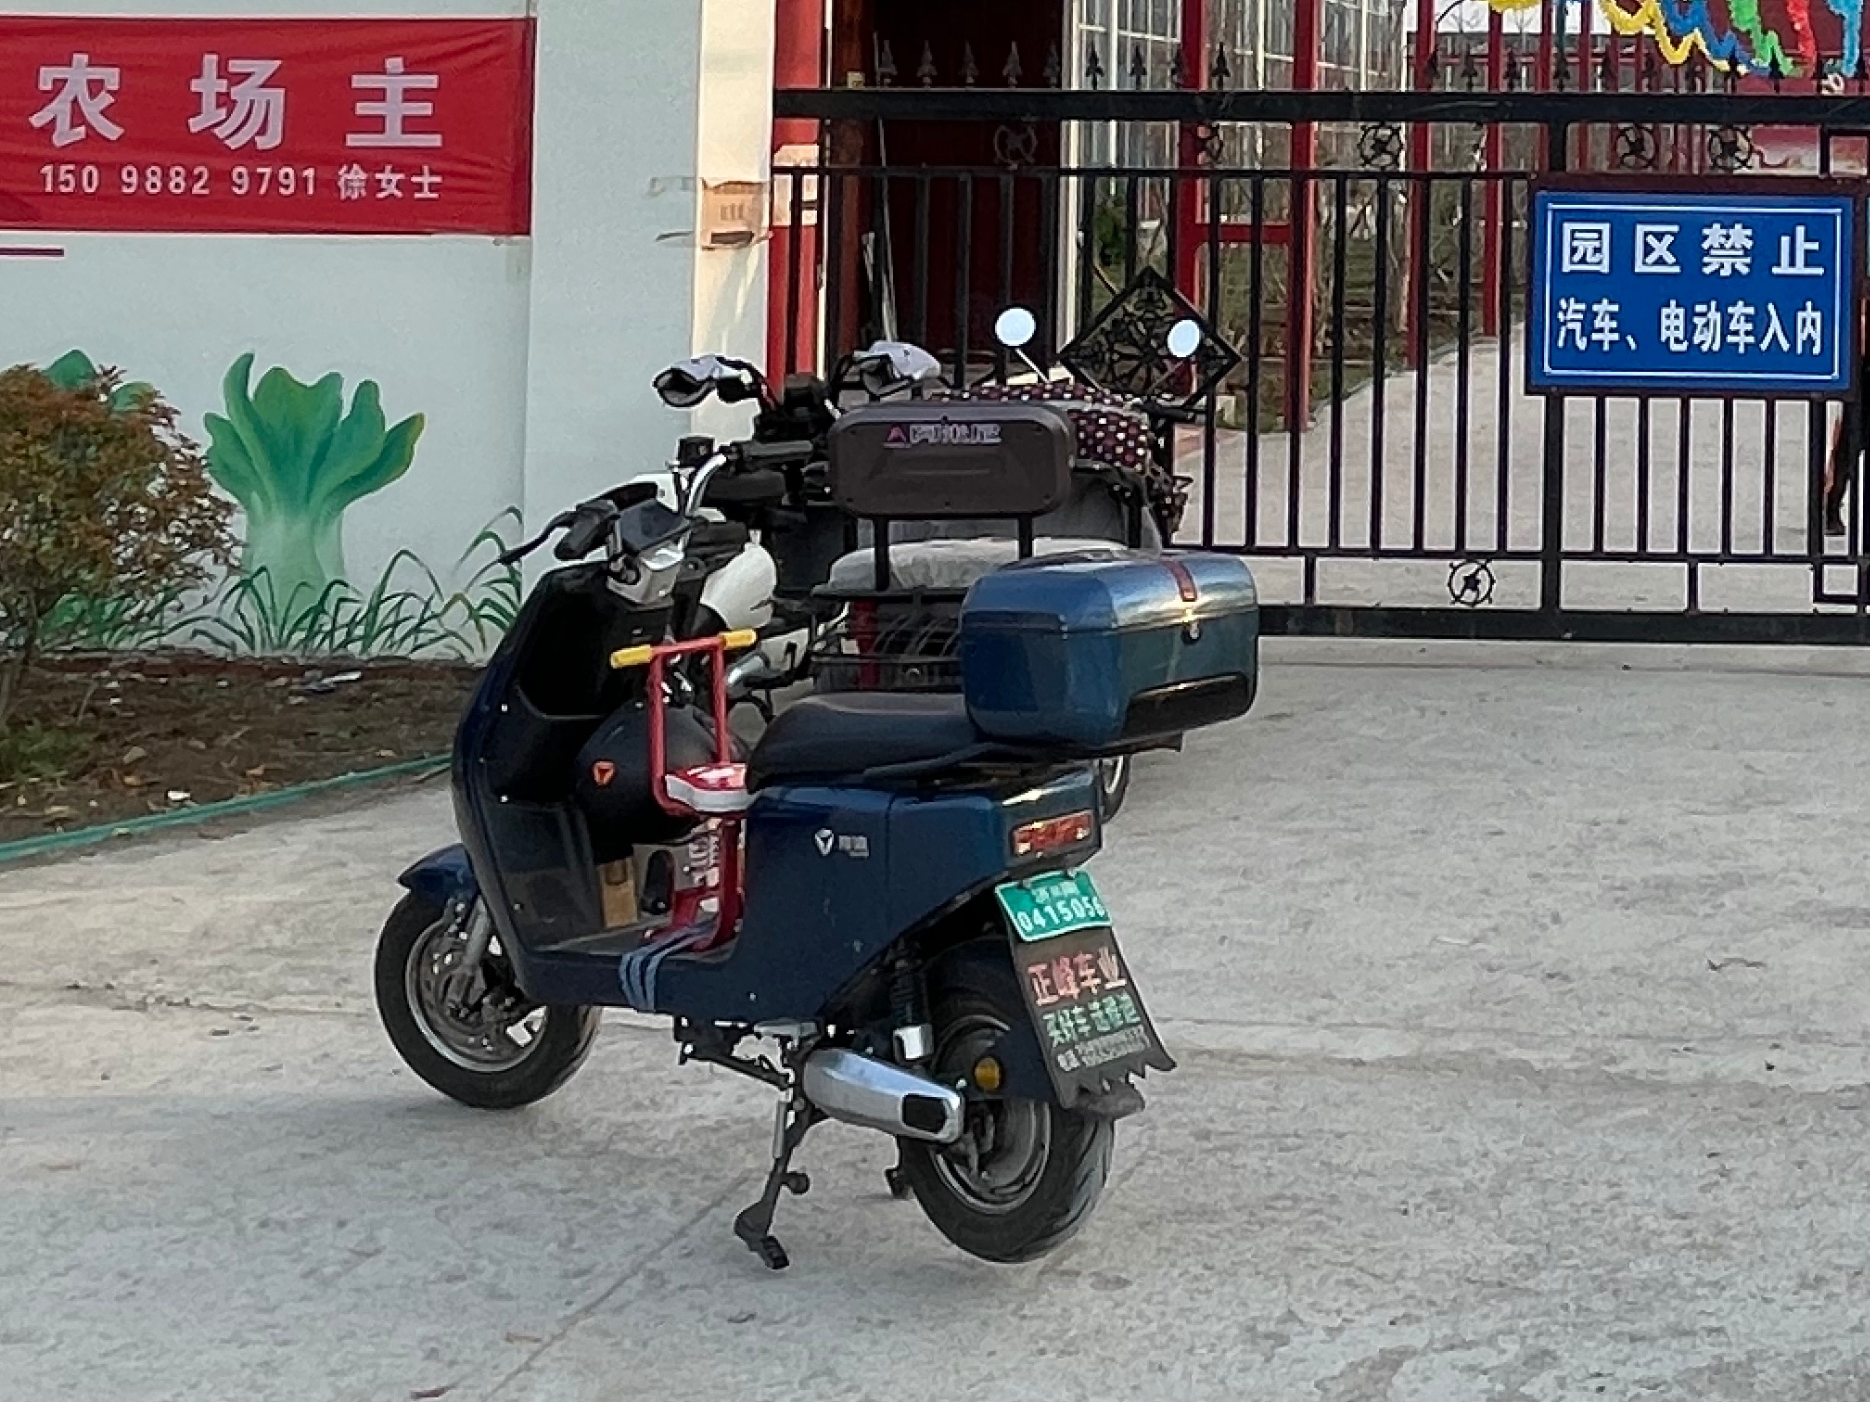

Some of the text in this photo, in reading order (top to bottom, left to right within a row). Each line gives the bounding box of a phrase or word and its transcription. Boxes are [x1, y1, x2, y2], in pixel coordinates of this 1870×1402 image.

[28, 53, 442, 150] 农场主
[40, 163, 443, 200] 150 9882 9791 徐女士
[1561, 221, 1825, 277] 园区禁止
[1556, 296, 1823, 356] 汽车、电动车入内
